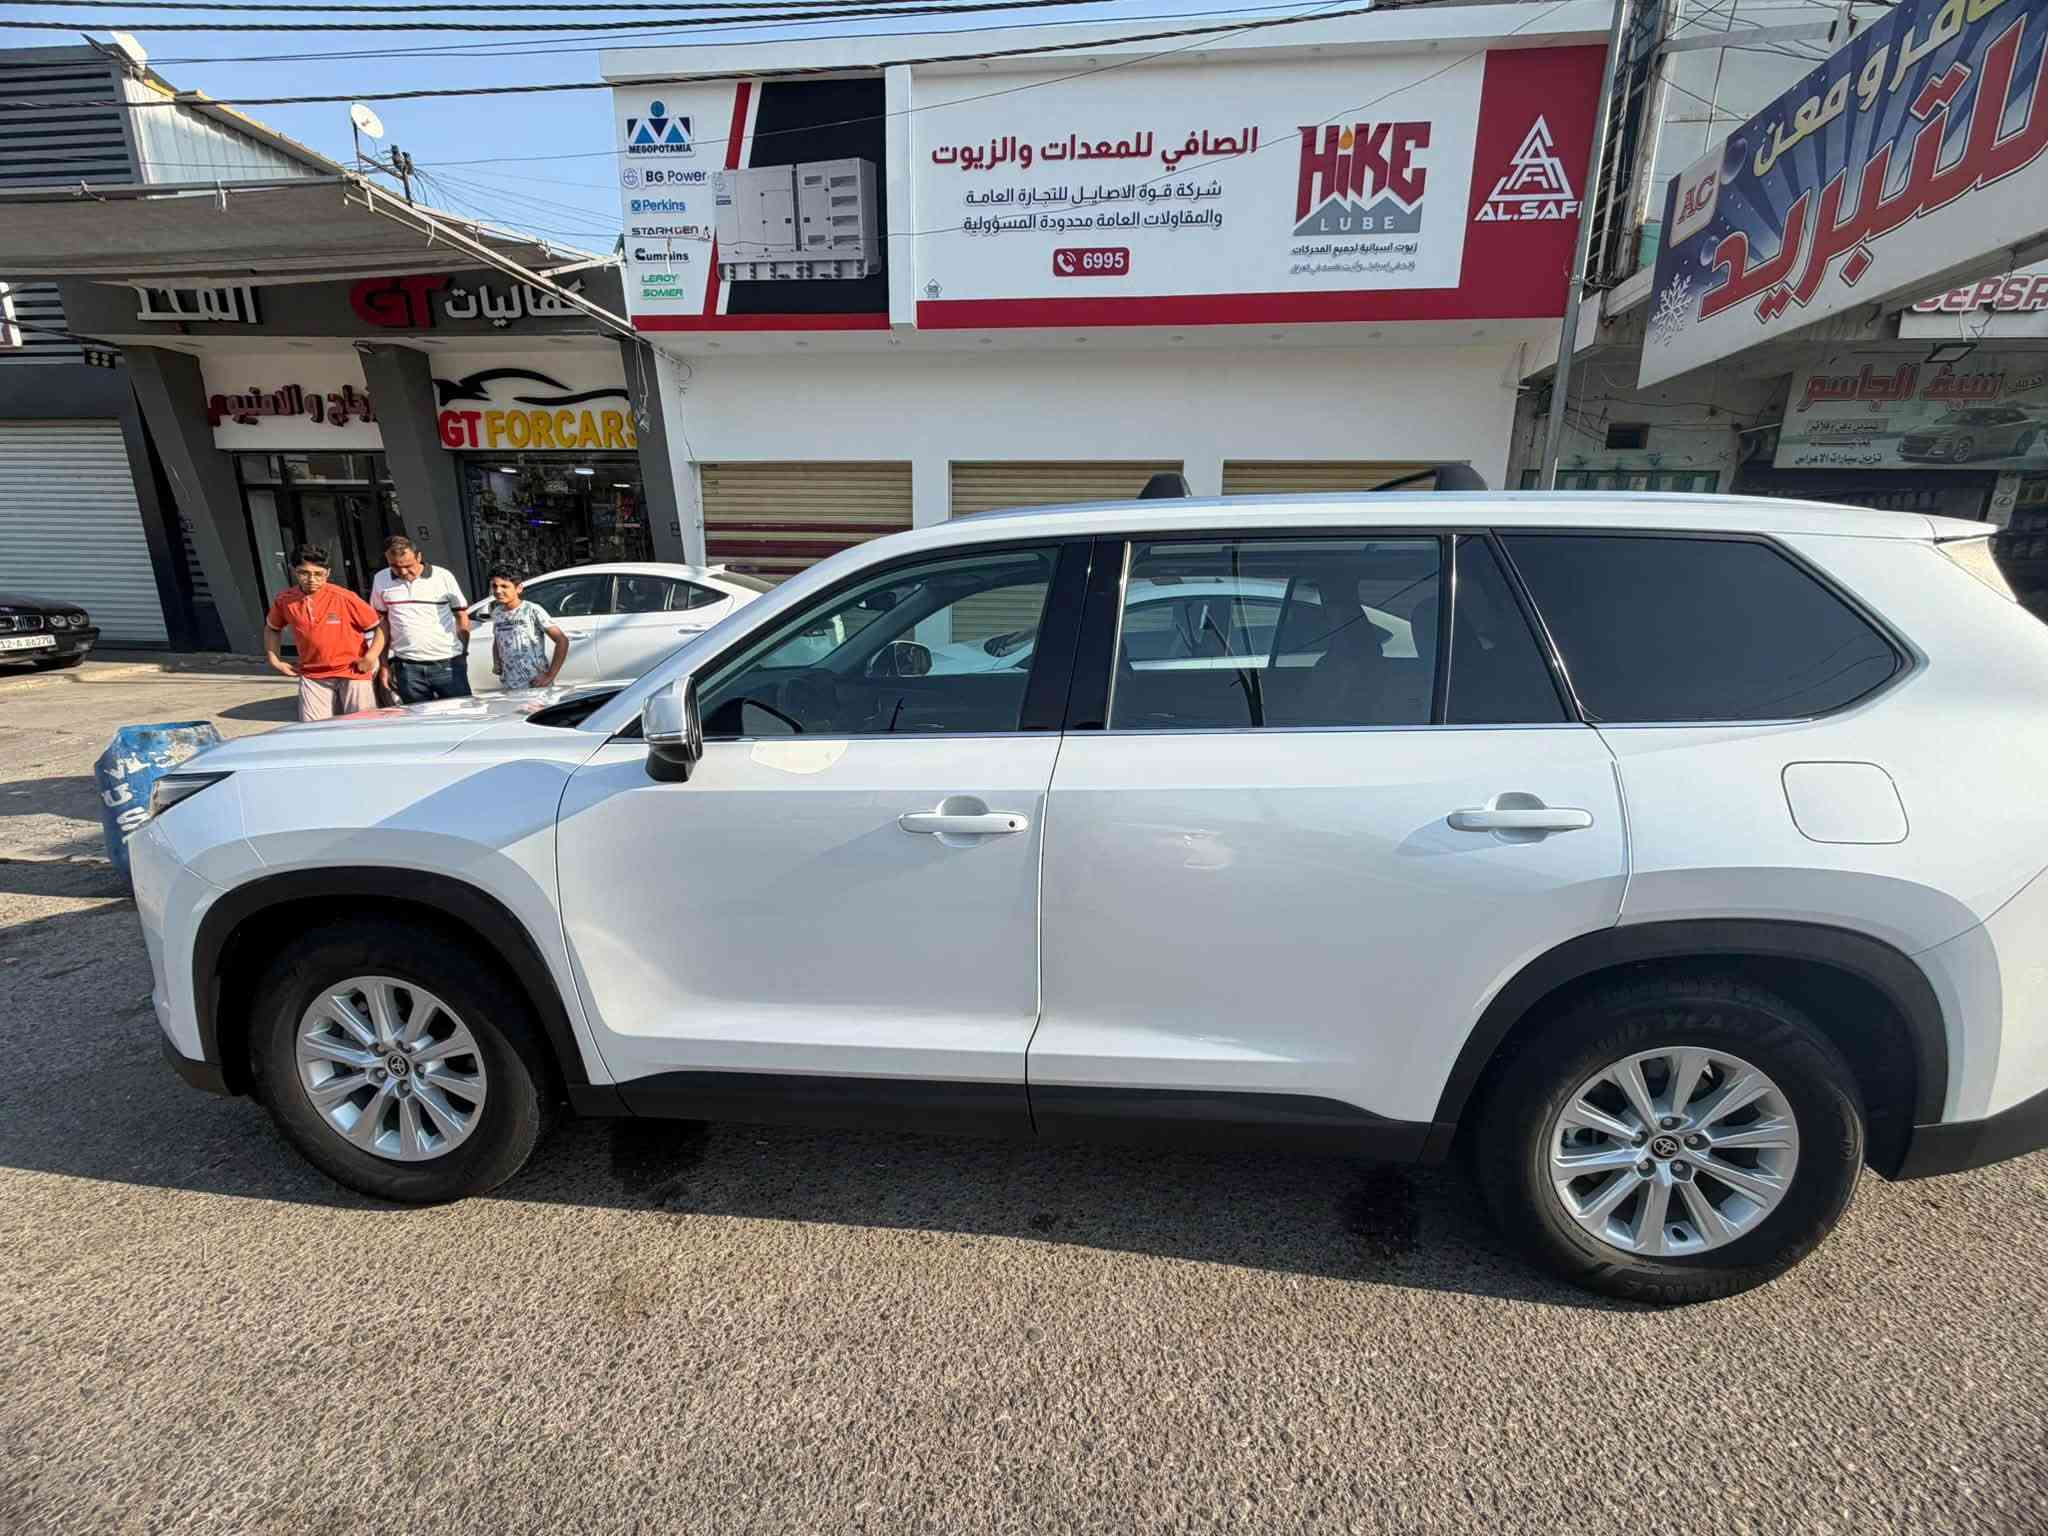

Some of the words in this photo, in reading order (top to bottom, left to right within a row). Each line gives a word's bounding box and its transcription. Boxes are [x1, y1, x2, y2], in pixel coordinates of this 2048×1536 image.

[628, 143, 692, 154] MESOPOTAMIA
[932, 136, 1033, 170] والزيوت
[1041, 131, 1152, 161] للمعدات
[1161, 126, 1259, 171] الصافي
[645, 170, 664, 183] BG
[667, 170, 706, 182] Power
[966, 188, 1014, 206] العامة
[1018, 187, 1067, 206] للتجارة
[1139, 182, 1172, 199] قوة
[1177, 180, 1222, 198] شركة
[642, 199, 686, 212] Perkins
[963, 216, 1037, 235] المسؤولية
[1040, 213, 1093, 231] محدودة
[1096, 211, 1141, 230] العامة
[1144, 209, 1223, 229] والمقاولات
[1320, 215, 1395, 232] LUBE
[1083, 252, 1124, 270] 6995
[641, 273, 678, 283] LEROY
[351, 275, 449, 329] GT
[643, 288, 683, 298] SOMER
[438, 410, 482, 448] GT
